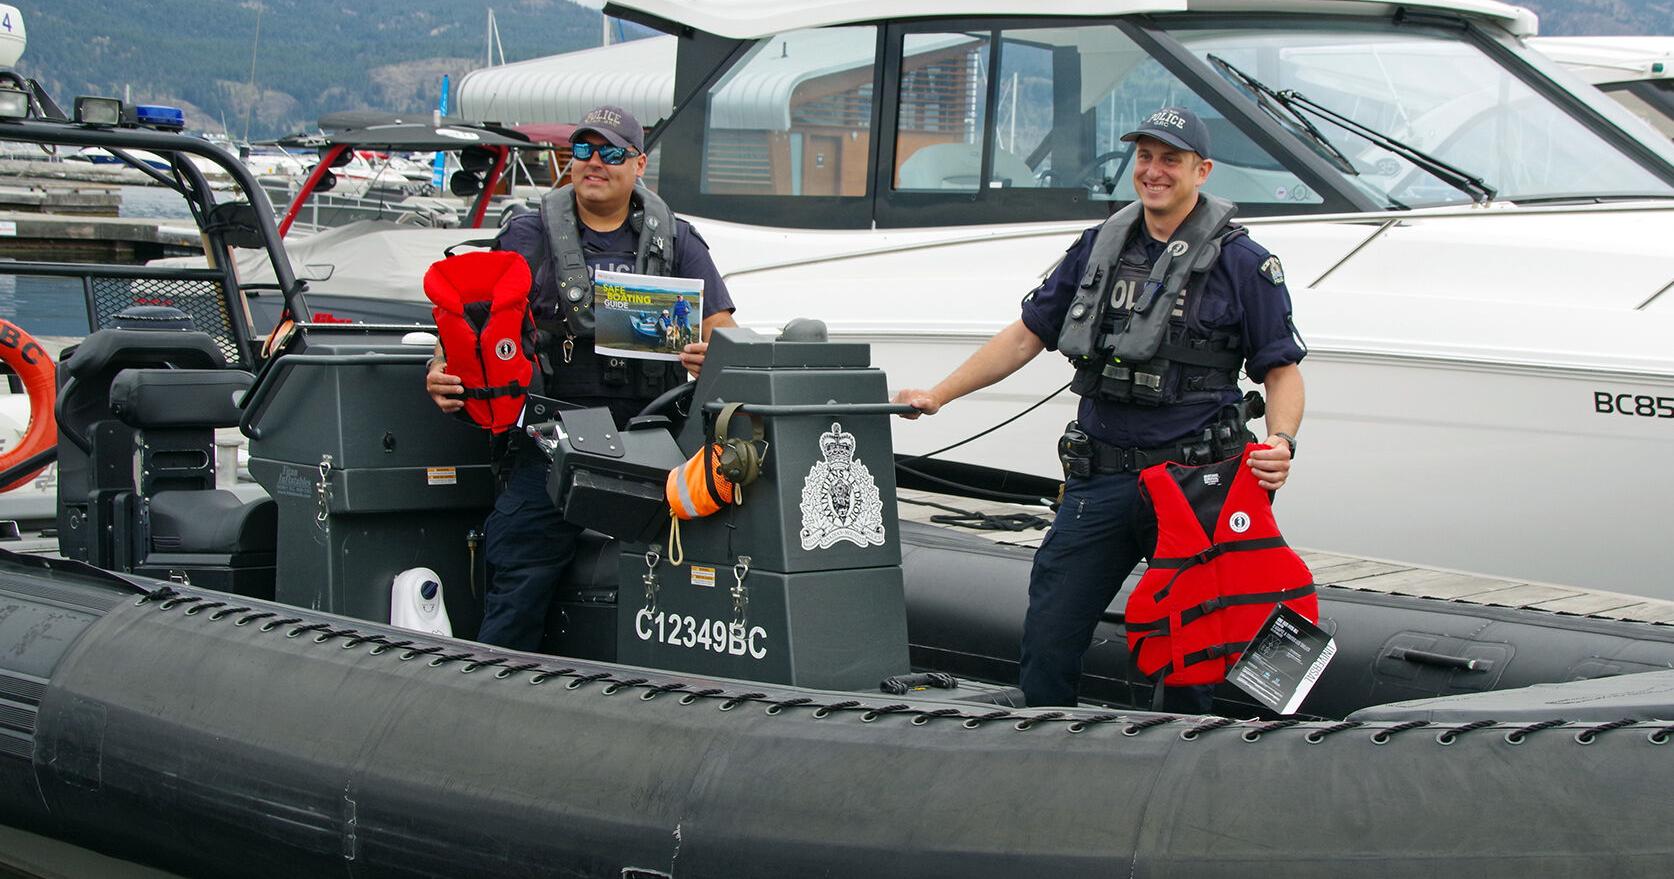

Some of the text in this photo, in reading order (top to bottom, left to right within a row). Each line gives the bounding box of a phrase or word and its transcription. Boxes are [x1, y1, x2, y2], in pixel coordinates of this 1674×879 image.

[2, 12, 12, 32] 4
[585, 109, 622, 124] POLICE
[1147, 112, 1186, 129] POLICE
[602, 283, 625, 295] SAFE
[604, 299, 629, 309] GUIDE
[607, 292, 651, 304] BOATING
[635, 608, 767, 660] C12349BC
